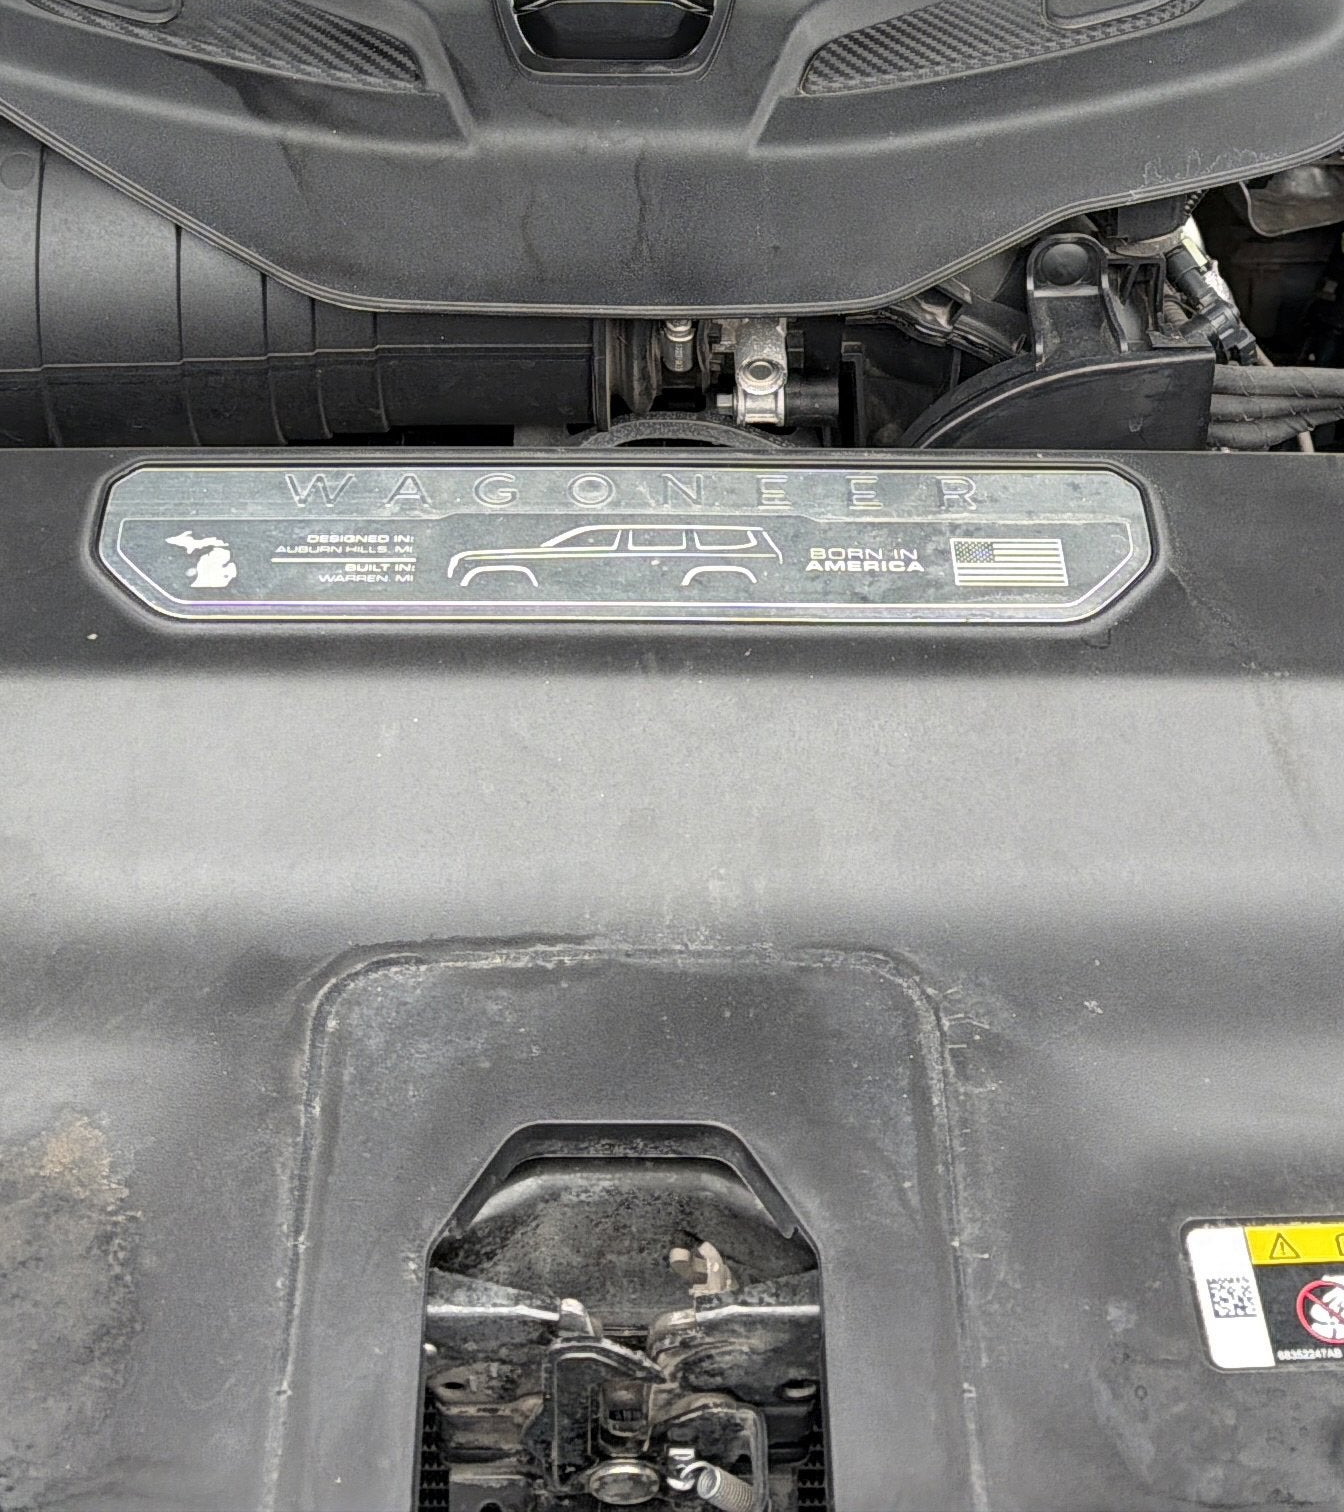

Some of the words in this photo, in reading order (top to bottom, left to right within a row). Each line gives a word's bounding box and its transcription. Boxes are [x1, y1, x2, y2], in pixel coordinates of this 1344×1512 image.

[284, 472, 978, 511] WAGONEER
[306, 534, 390, 544] DESIGNED
[393, 534, 415, 544] IN:
[274, 545, 343, 554] AUBURN
[394, 545, 413, 554] MI
[810, 547, 884, 561] BORN
[892, 547, 918, 561] IN
[344, 563, 391, 572] BUILT
[394, 563, 416, 572] IN:
[805, 560, 925, 573] AMERICA
[394, 574, 414, 583] MI
